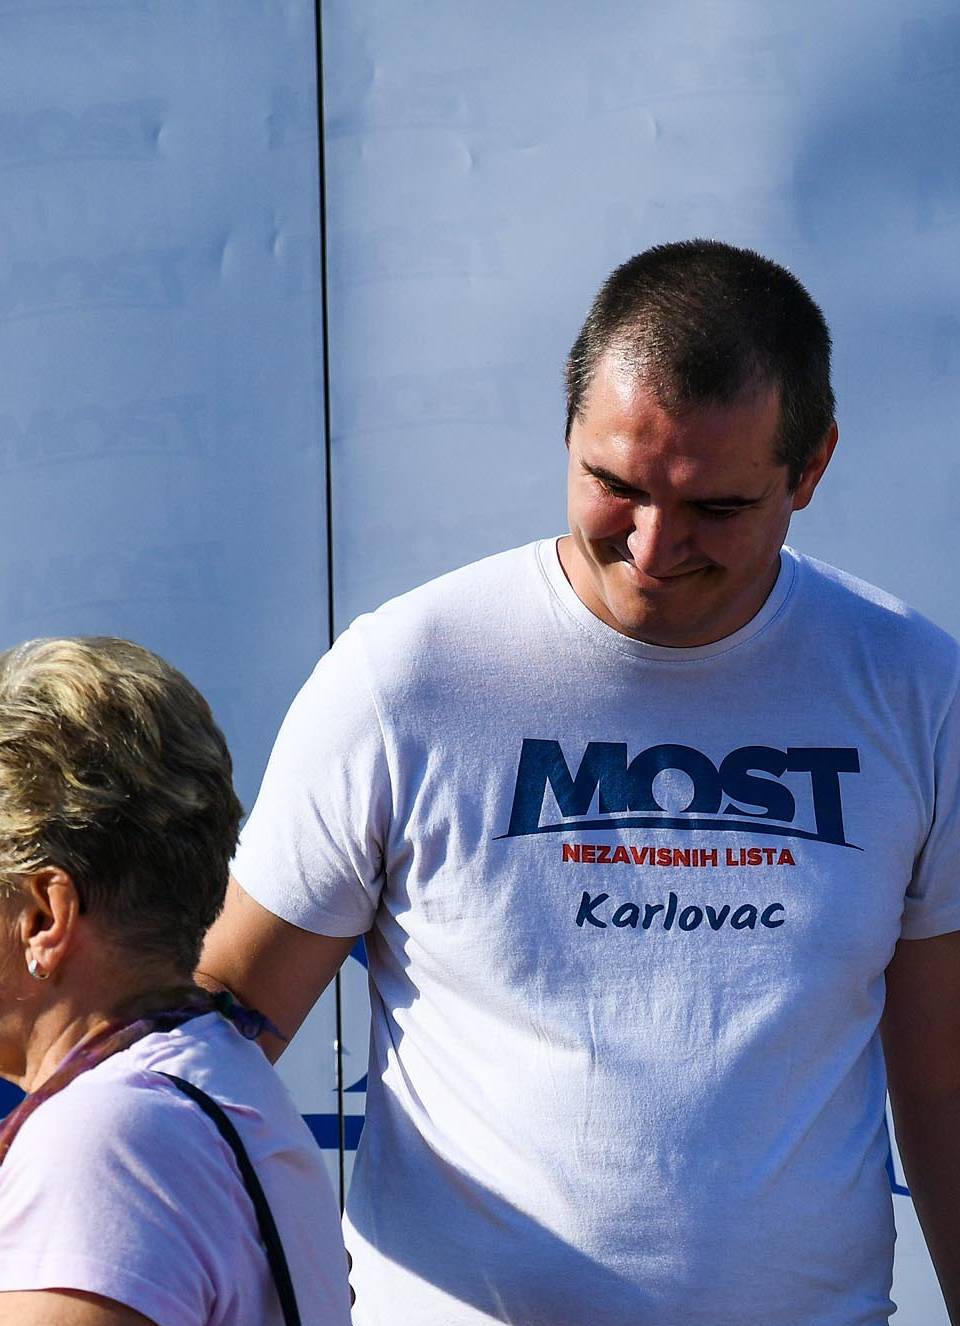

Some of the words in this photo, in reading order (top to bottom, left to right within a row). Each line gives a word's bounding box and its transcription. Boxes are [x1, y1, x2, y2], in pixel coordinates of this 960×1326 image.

[506, 738, 861, 847] MOST
[562, 843, 718, 867] NEZAVISNIH
[725, 848, 796, 866] LISTA
[575, 890, 785, 932] Karlovac
